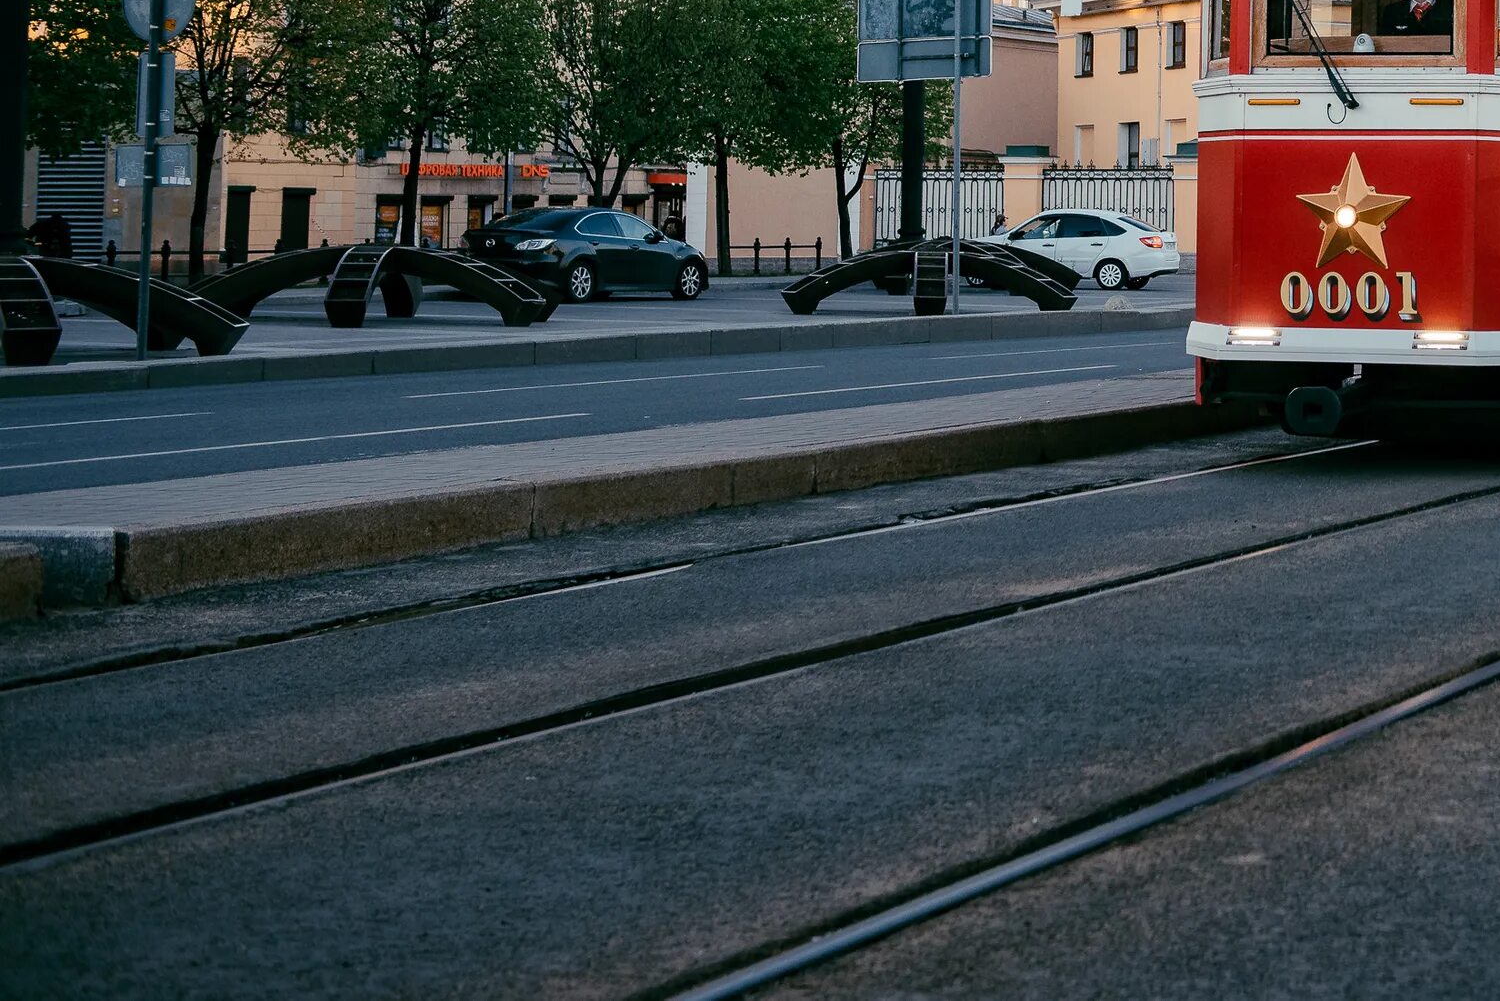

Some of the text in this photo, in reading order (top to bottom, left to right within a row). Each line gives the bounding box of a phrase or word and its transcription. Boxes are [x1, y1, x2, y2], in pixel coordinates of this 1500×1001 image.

[401, 163, 503, 177] ЦФРОВАЯ ТЕХНИКА
[521, 163, 550, 177] DNS
[1280, 271, 1420, 319] 0001
